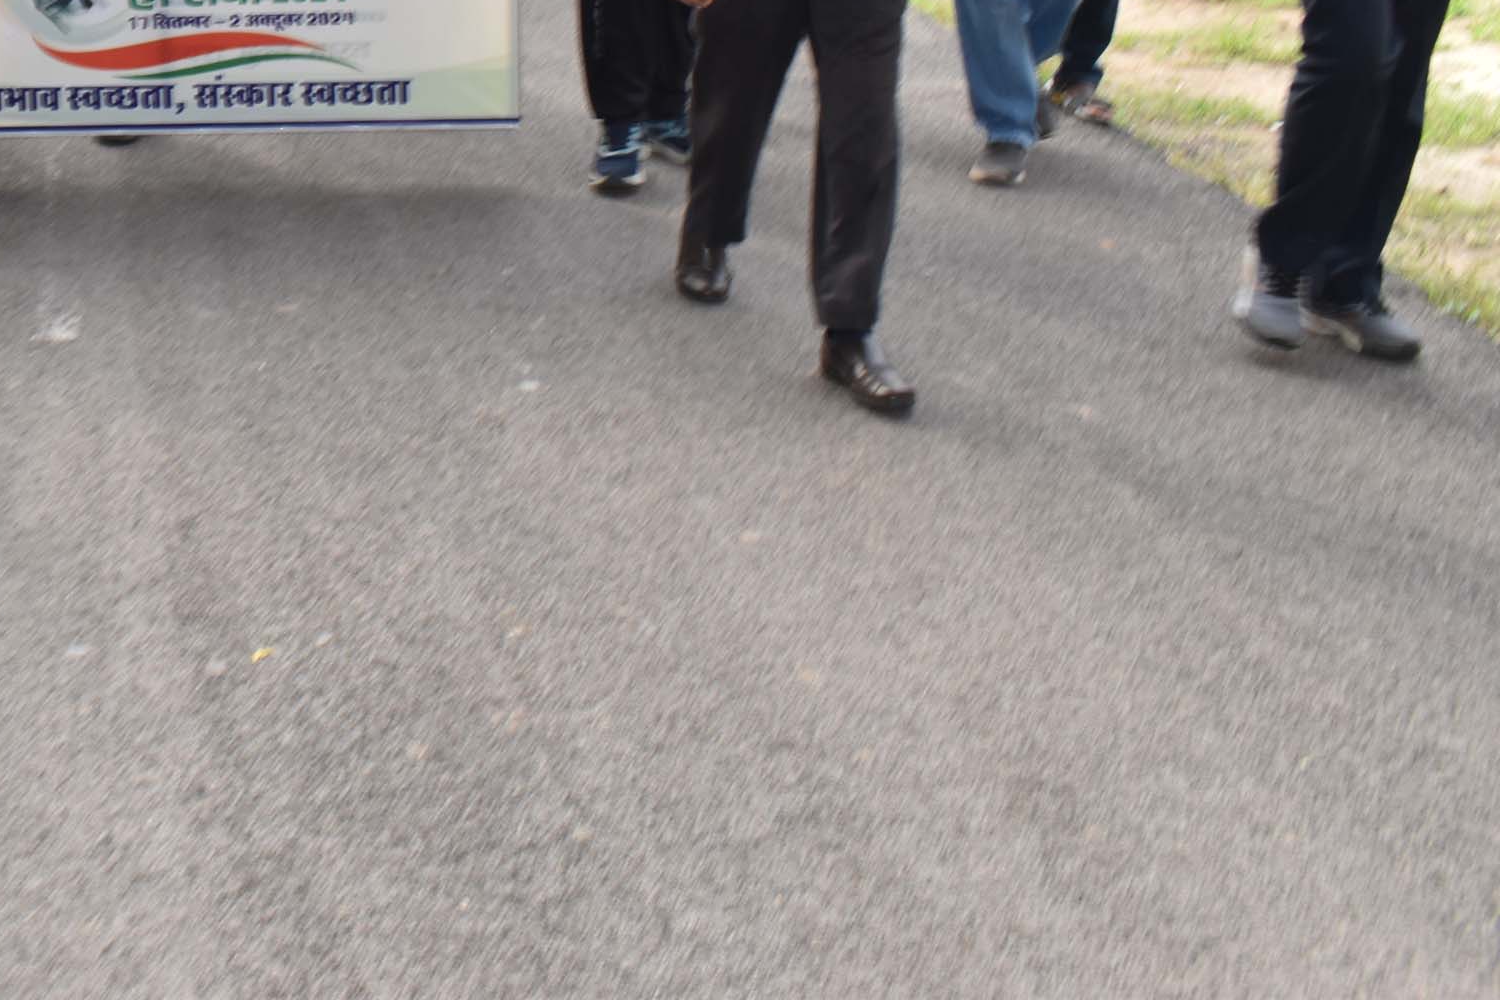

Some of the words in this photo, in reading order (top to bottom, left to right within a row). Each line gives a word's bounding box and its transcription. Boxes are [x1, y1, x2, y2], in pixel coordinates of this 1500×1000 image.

[127, 15, 148, 31] 17
[229, 14, 240, 28] 2
[65, 85, 186, 115] स्वच्छता,
[192, 74, 295, 108] संस्कार
[299, 79, 412, 107] स्वच्छता
